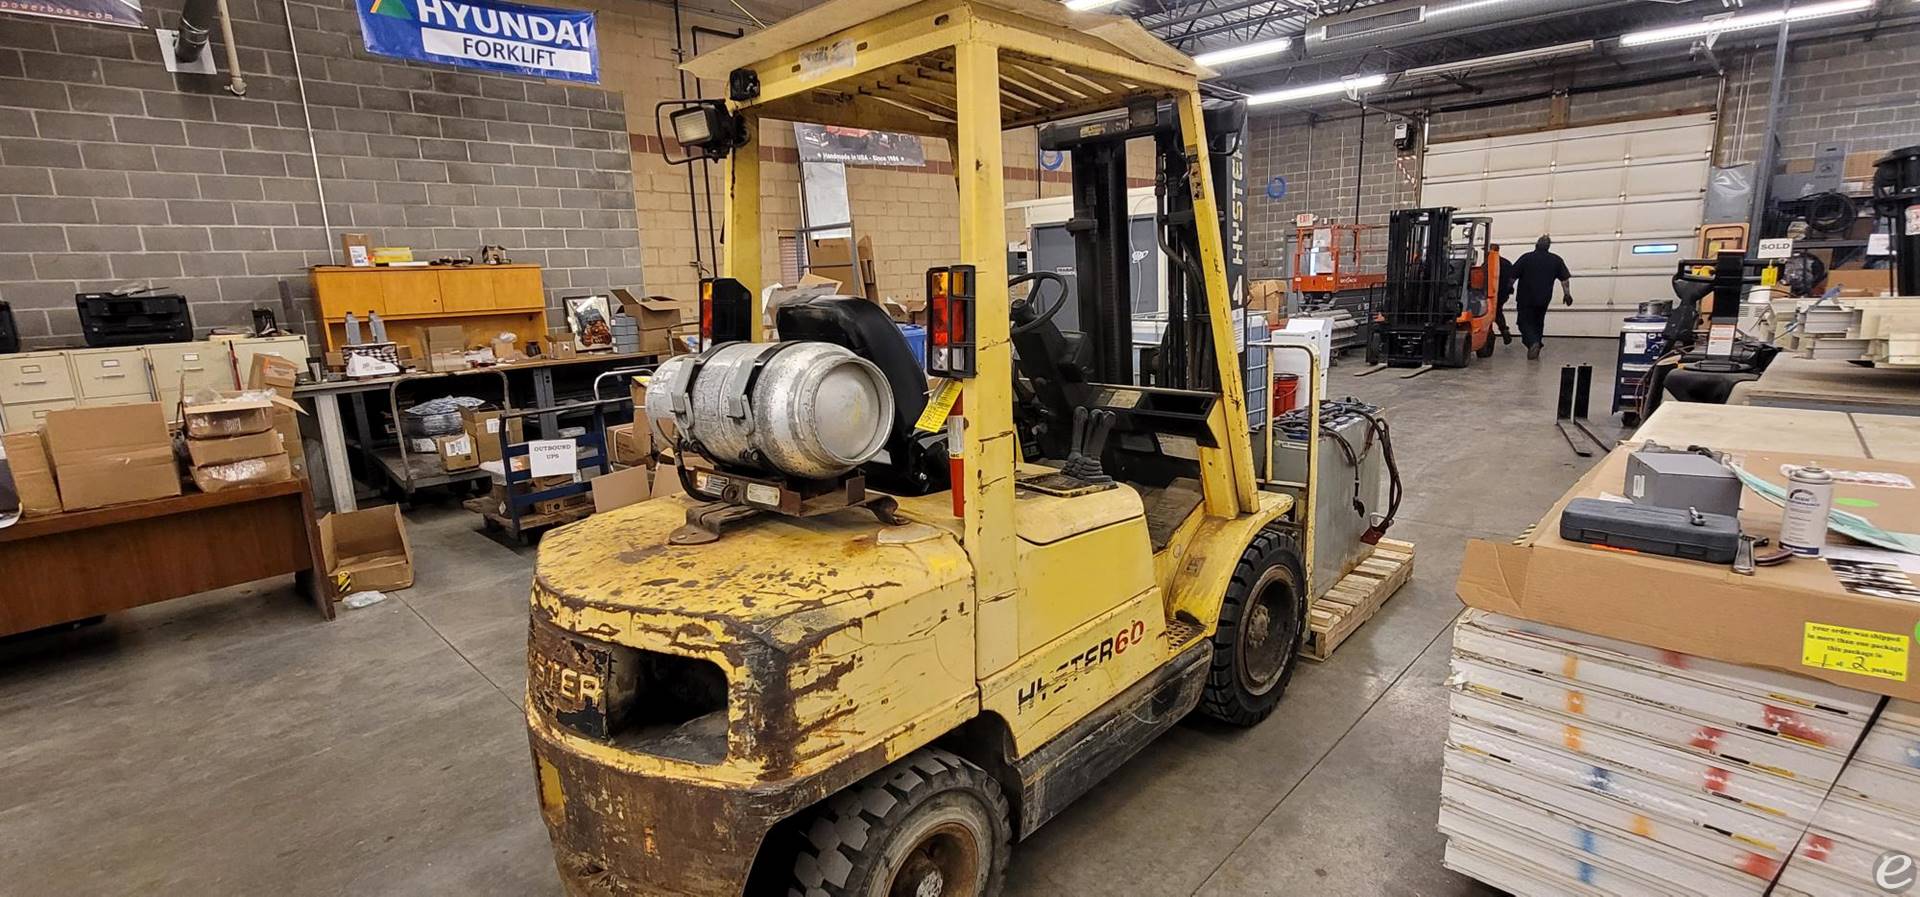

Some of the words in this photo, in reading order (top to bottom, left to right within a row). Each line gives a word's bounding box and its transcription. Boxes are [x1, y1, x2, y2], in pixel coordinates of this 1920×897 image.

[416, 0, 590, 49] HYUNDAI
[463, 37, 557, 67] FORKLIFT
[823, 152, 850, 161] Handmade
[534, 444, 571, 452] OUTBOUND
[1870, 632, 1901, 642] shipped
[1827, 645, 1841, 653] this
[1843, 648, 1873, 657] package
[1852, 656, 1869, 672] 2
[1870, 667, 1903, 677] packages
